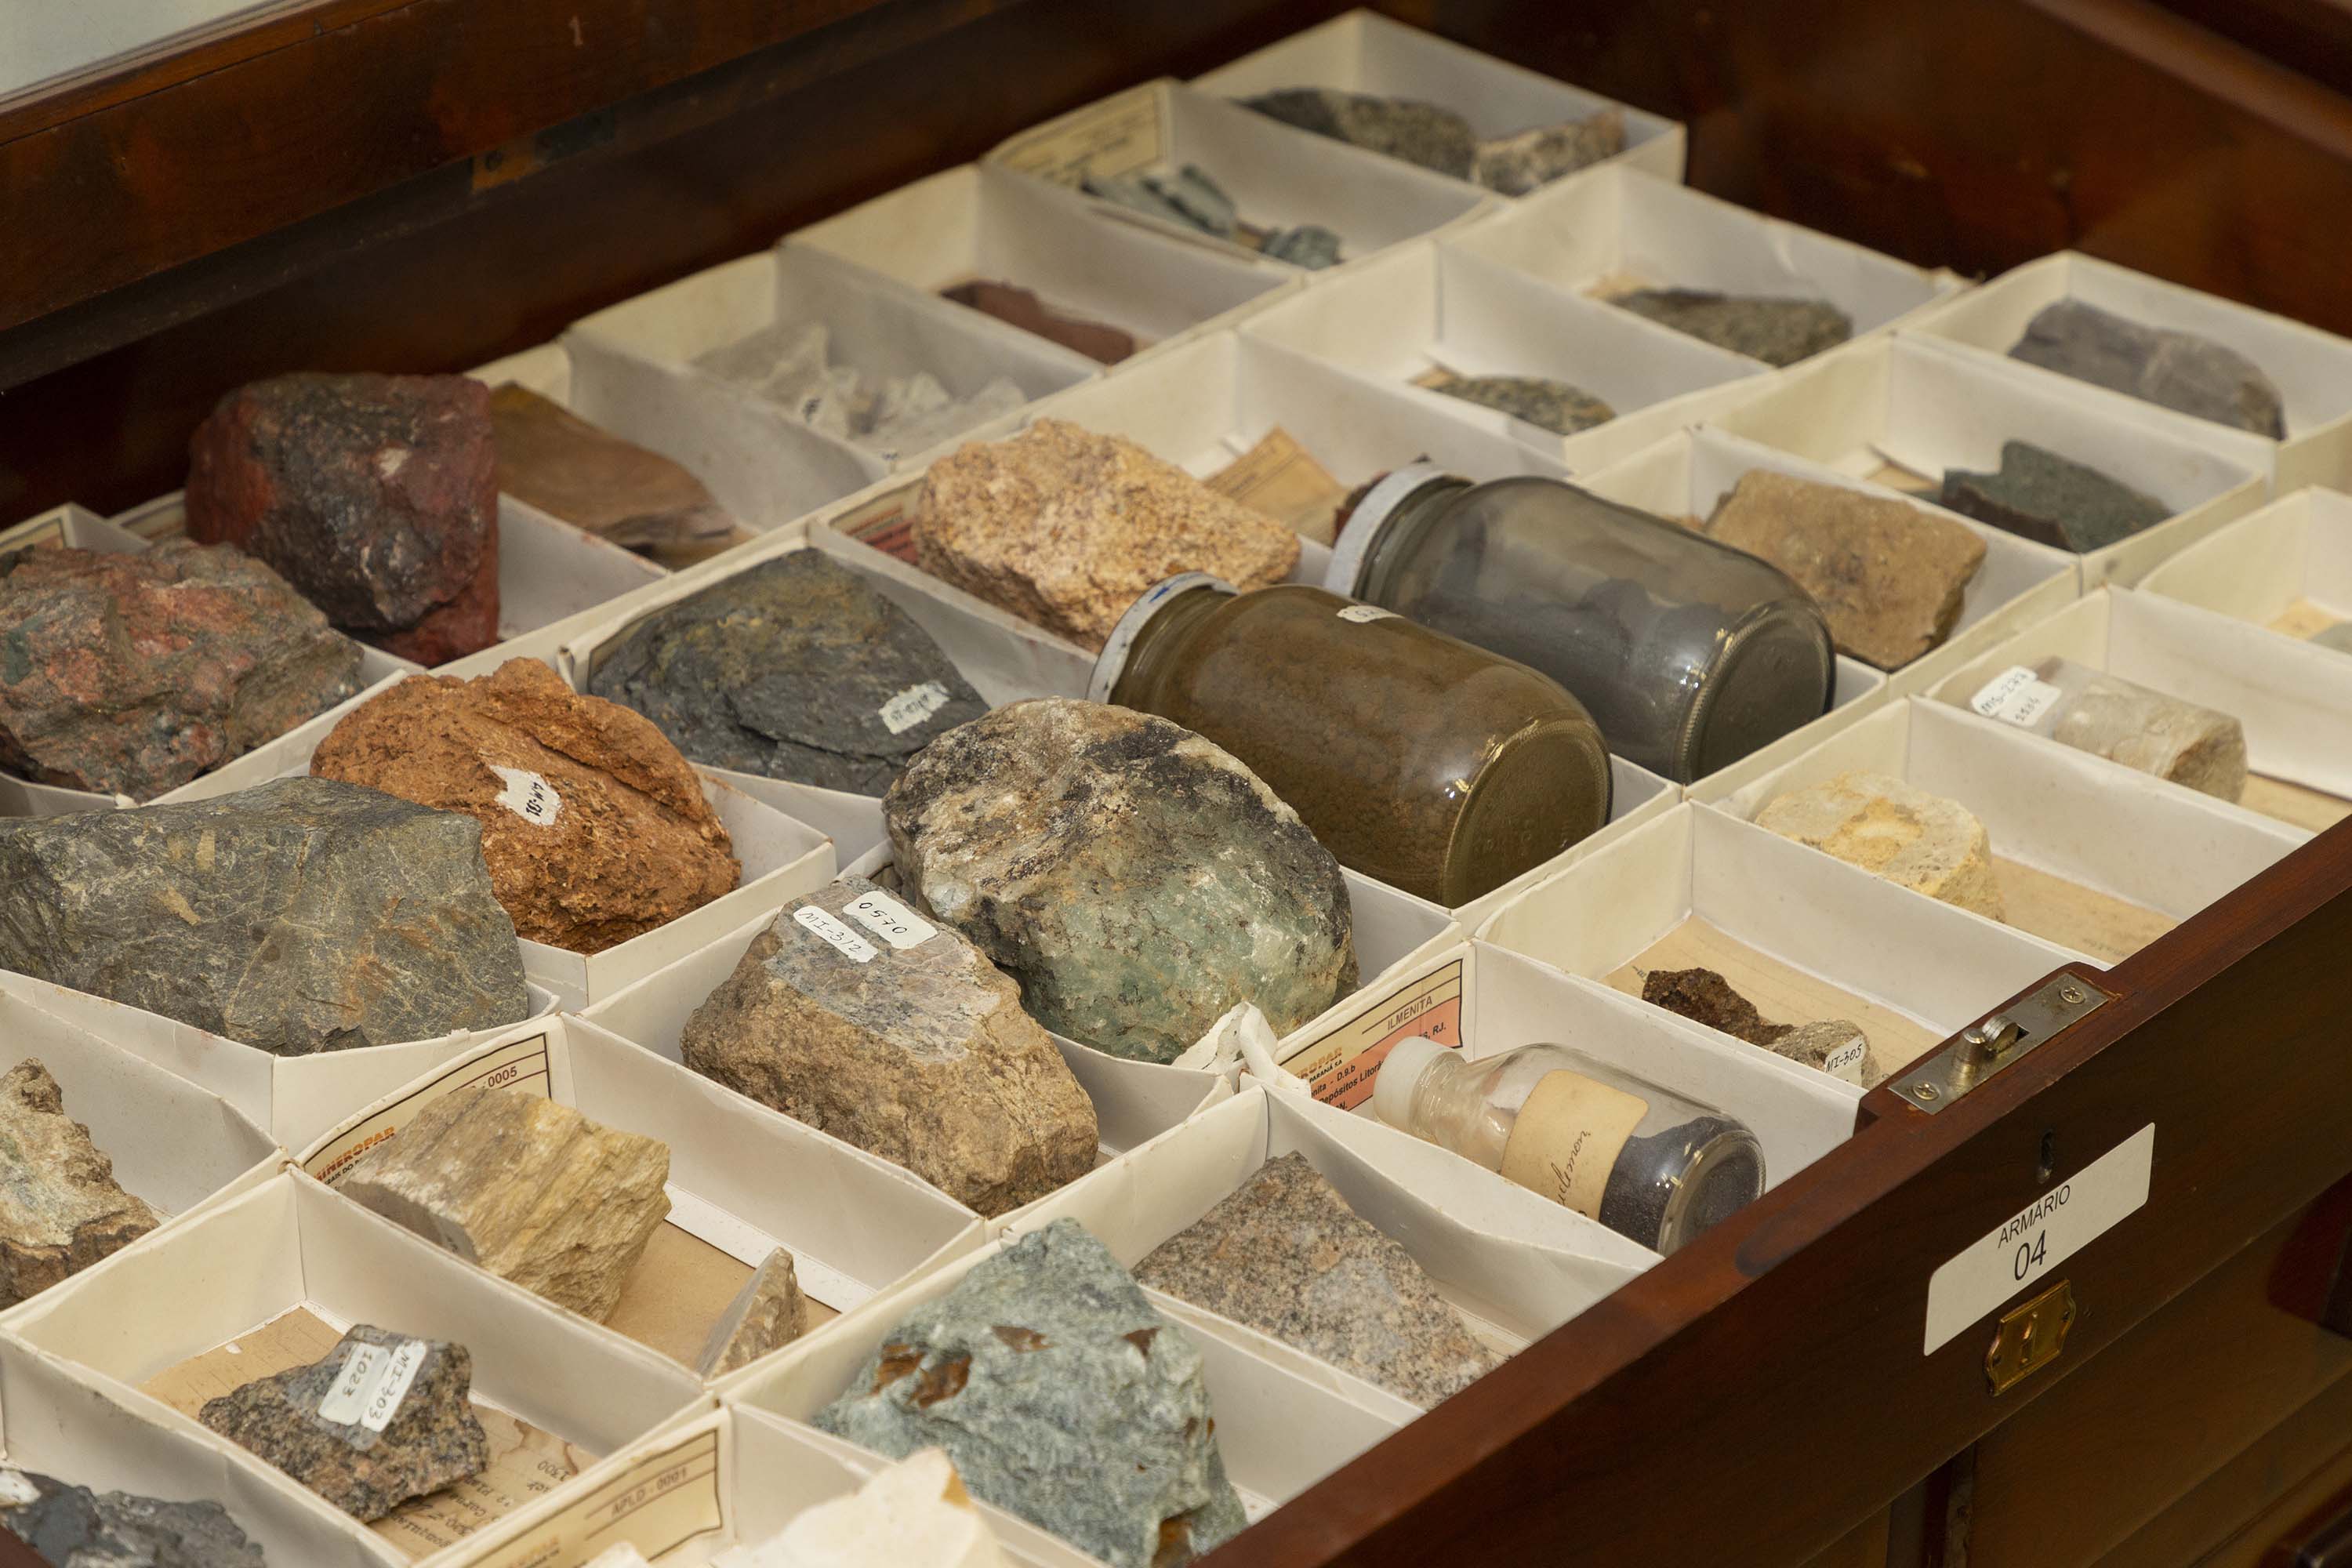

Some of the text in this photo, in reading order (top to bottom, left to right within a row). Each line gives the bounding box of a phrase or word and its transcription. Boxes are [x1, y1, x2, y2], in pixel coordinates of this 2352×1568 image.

[798, 912, 862, 953] MI-312
[858, 902, 908, 934] 0570
[1387, 996, 1433, 1032] ILMENITA
[1432, 1022, 1447, 1036] RJ.
[487, 1065, 518, 1088] 0005
[1311, 1083, 1327, 1098] nita
[1337, 1064, 1356, 1082] D.9.b
[1997, 1184, 2071, 1249] ARMÁRIO
[2014, 1229, 2048, 1281] 04
